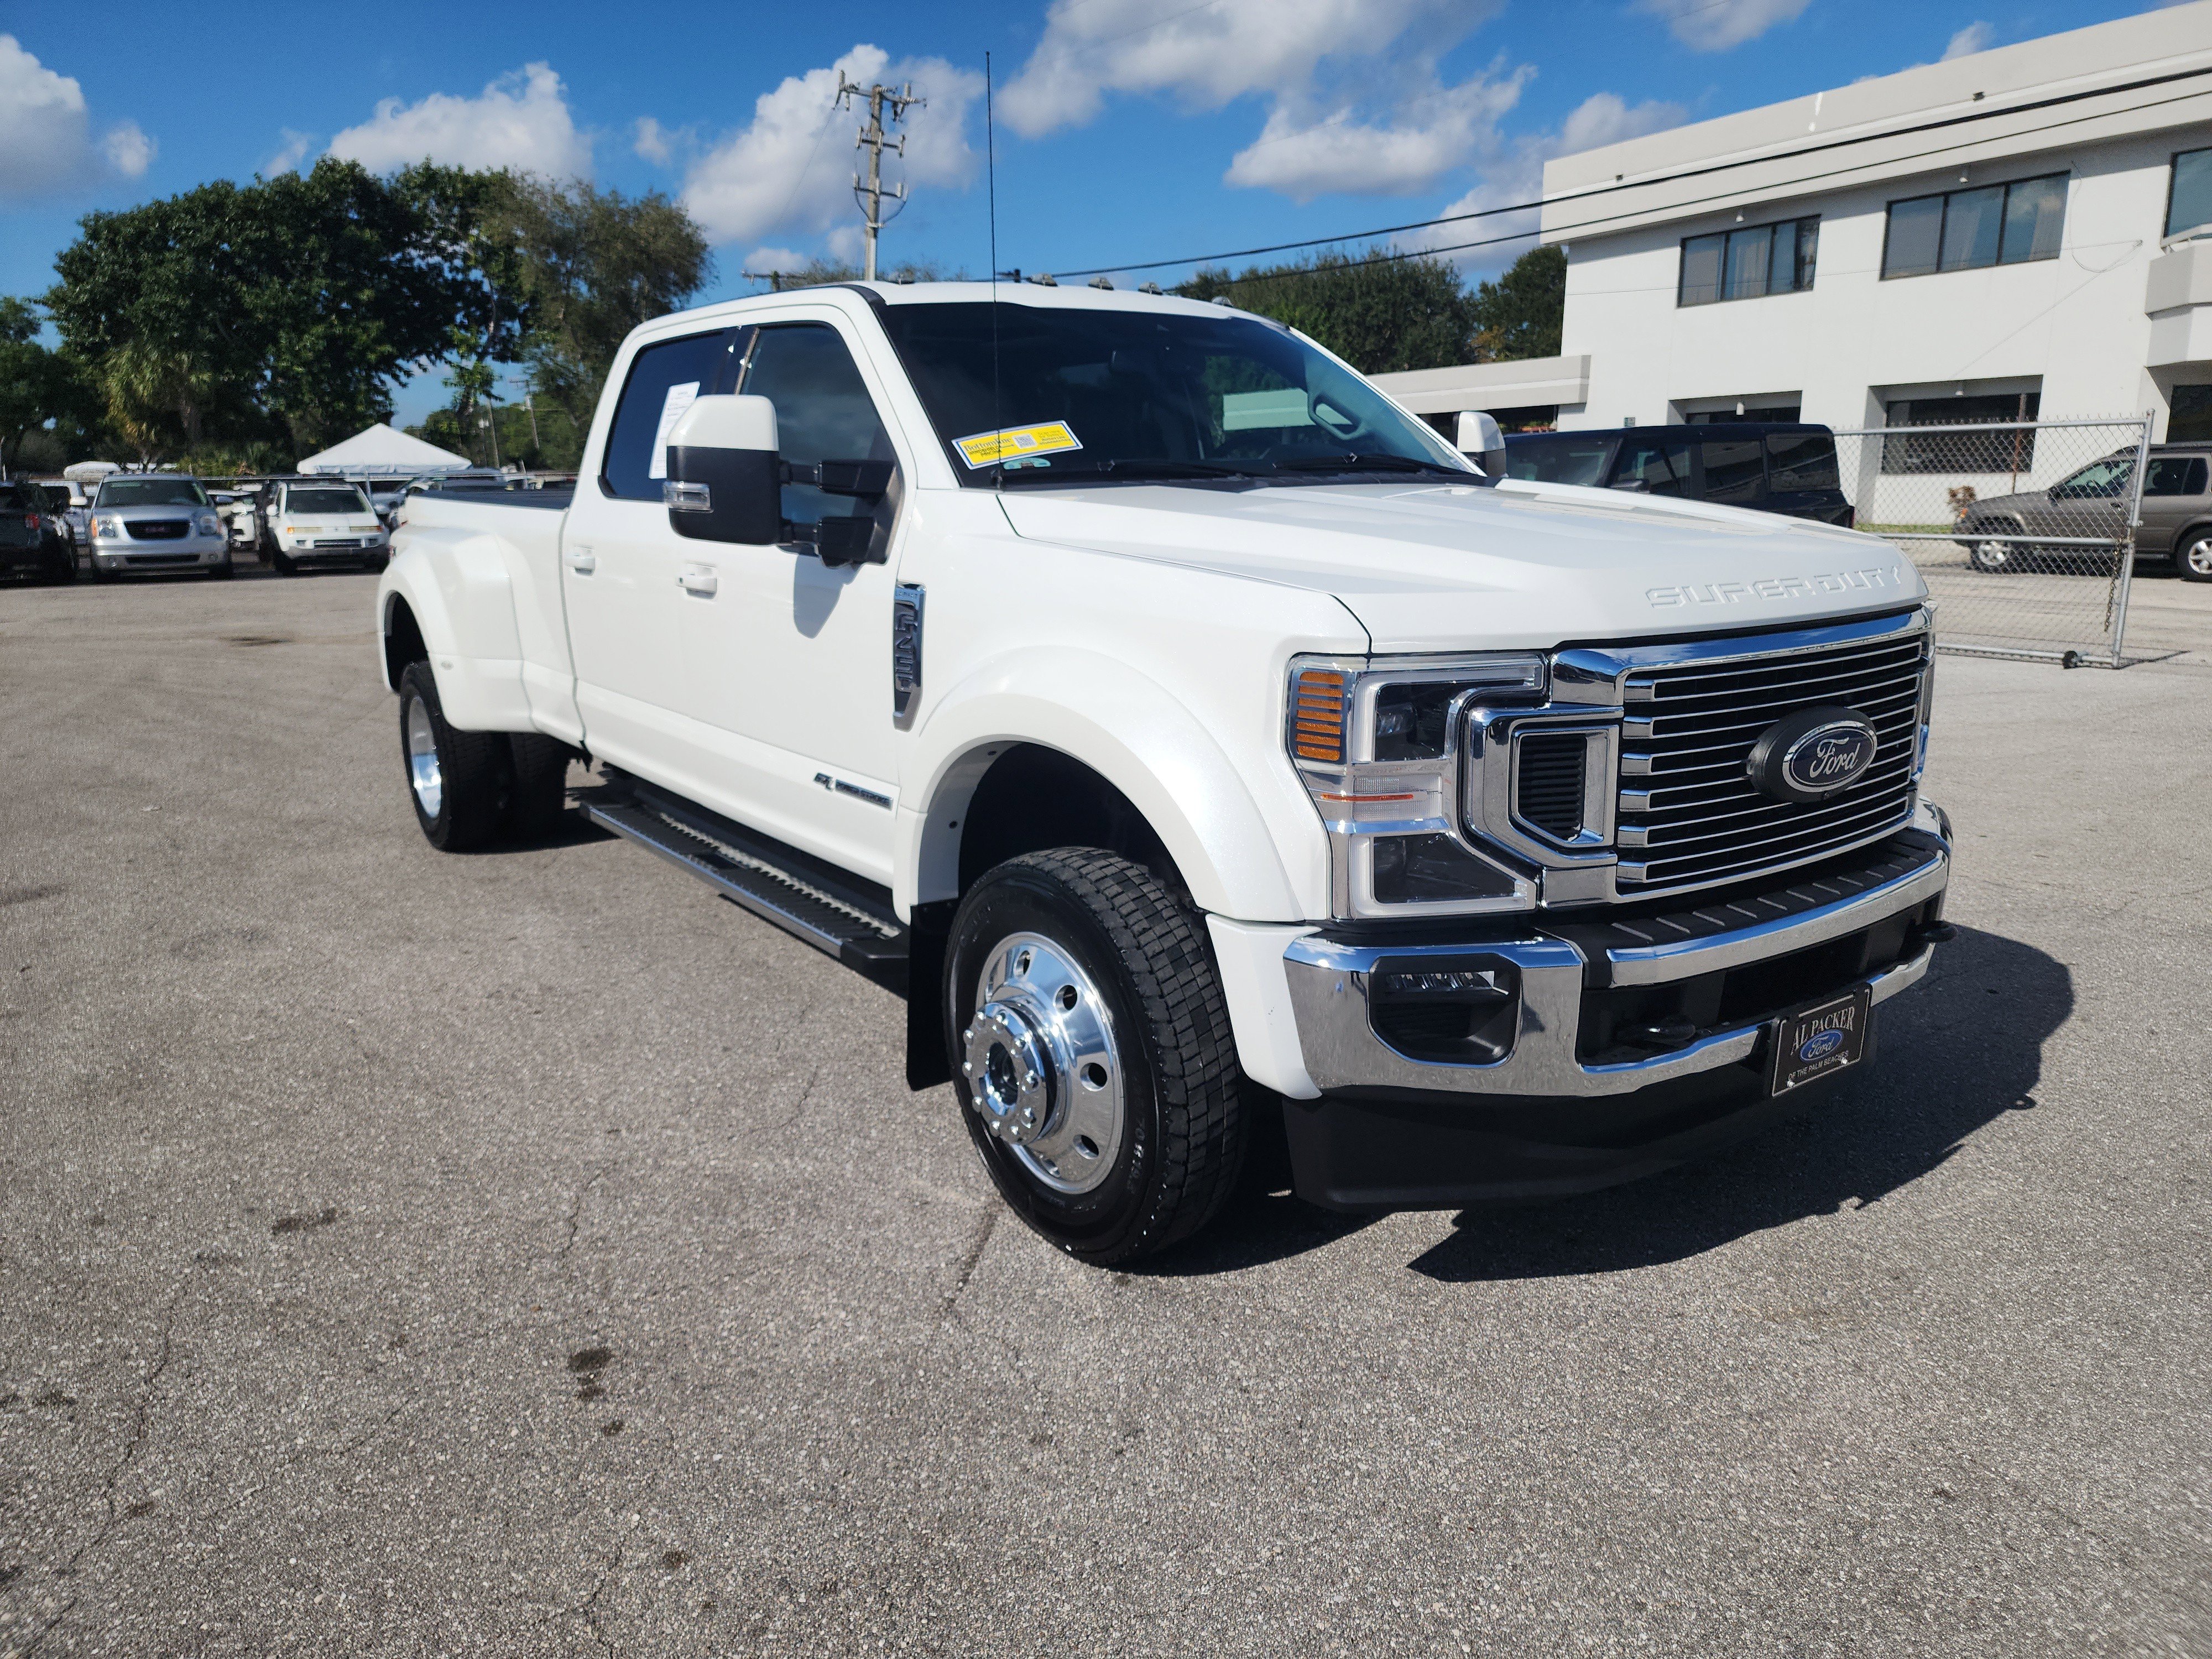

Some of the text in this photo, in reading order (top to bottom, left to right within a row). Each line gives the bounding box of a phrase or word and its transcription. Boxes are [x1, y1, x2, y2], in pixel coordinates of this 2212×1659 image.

[1645, 565, 1901, 609] SUPER DUTY
[1809, 736, 1860, 778] Ford
[1790, 1006, 1855, 1056] AL PACKER
[1808, 1035, 1835, 1058] Ford
[1808, 1060, 1823, 1073] PALM
